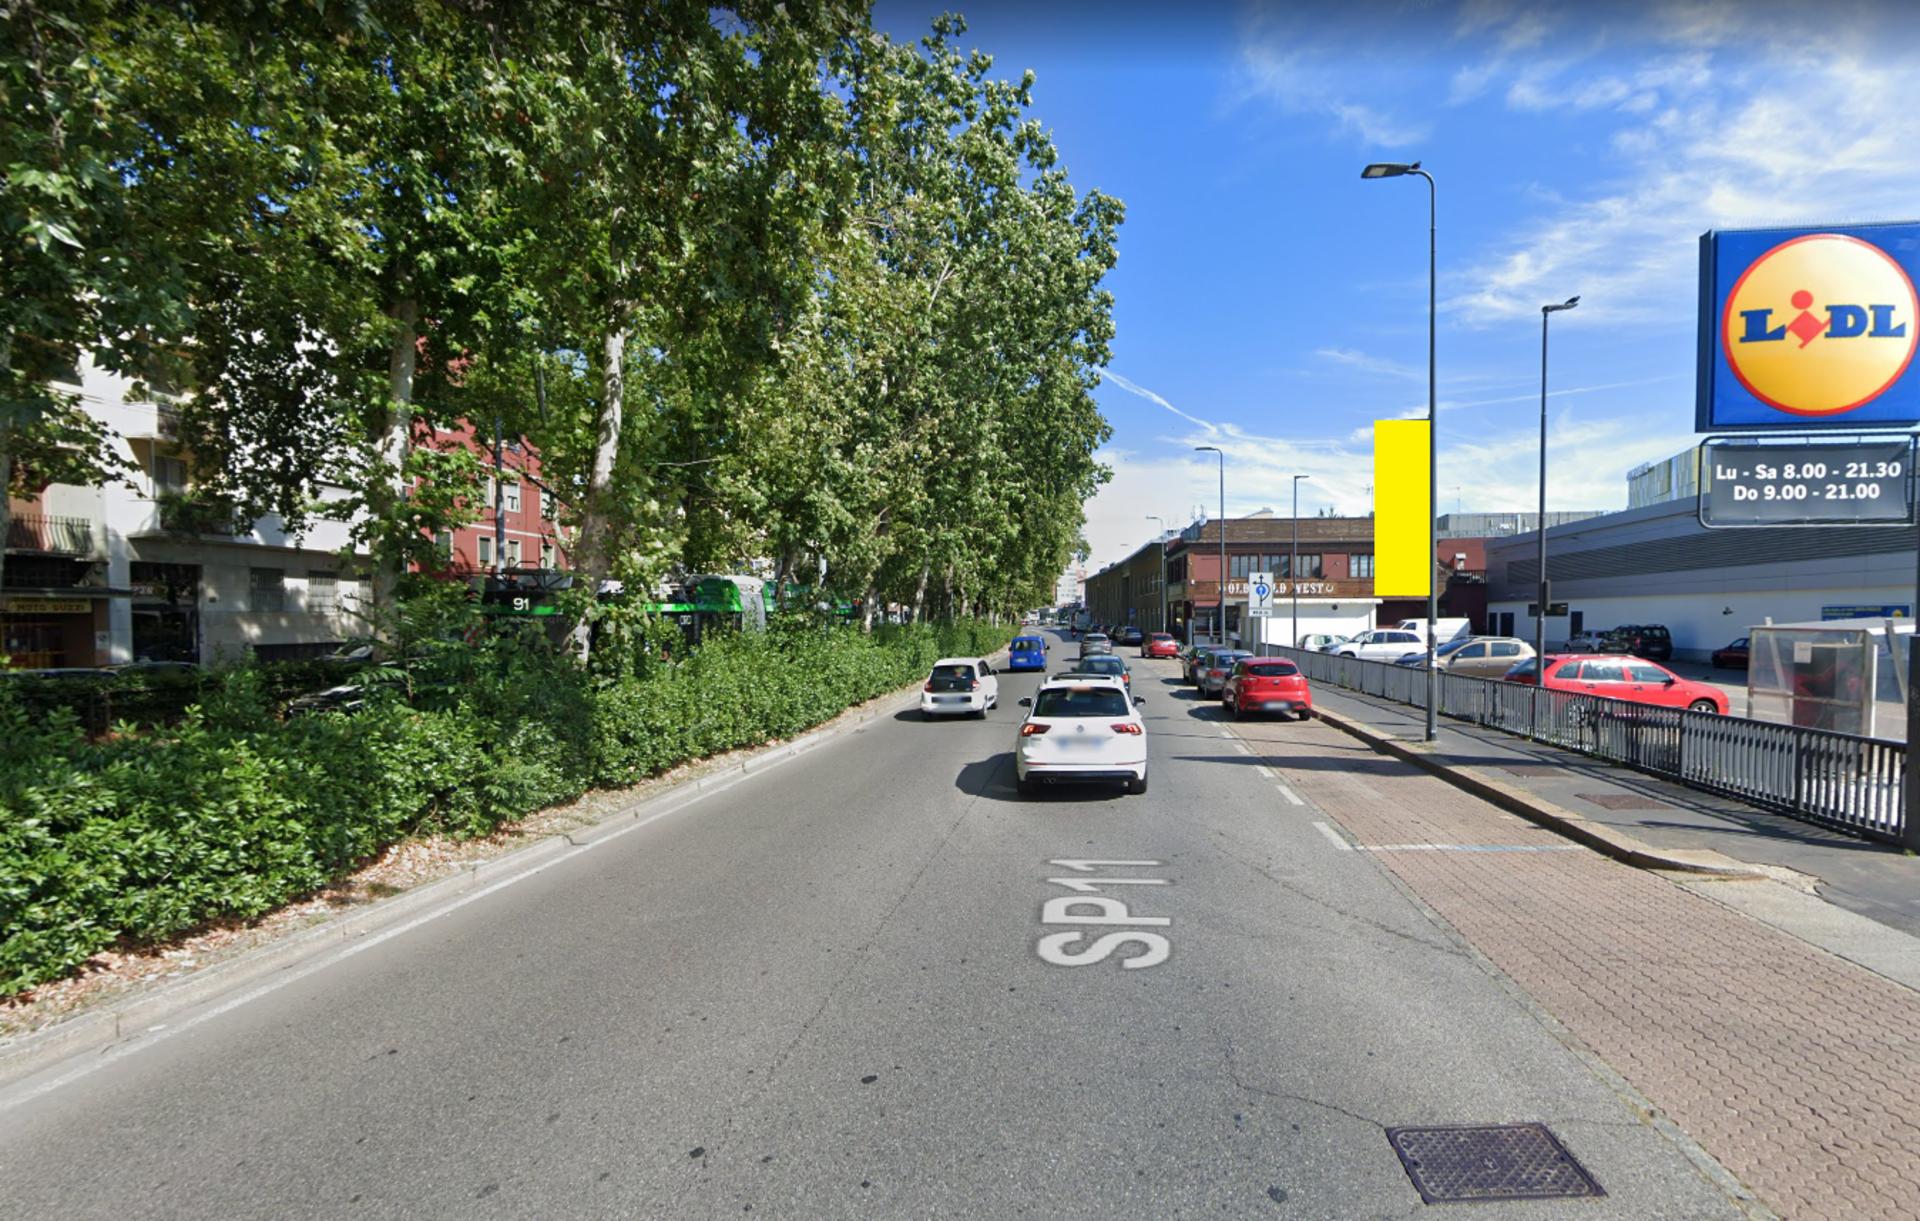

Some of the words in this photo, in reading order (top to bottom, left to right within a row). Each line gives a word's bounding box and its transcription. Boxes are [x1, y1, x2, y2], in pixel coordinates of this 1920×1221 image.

[1716, 464, 1737, 480] Lu
[1755, 464, 1777, 480] Sa
[1783, 463, 1827, 480] 8.00
[1846, 461, 1902, 478] 21.30
[1734, 485, 1758, 501] Do
[1763, 484, 1807, 500] 9.00
[1825, 483, 1880, 499] 21.00
[513, 597, 530, 611] 91
